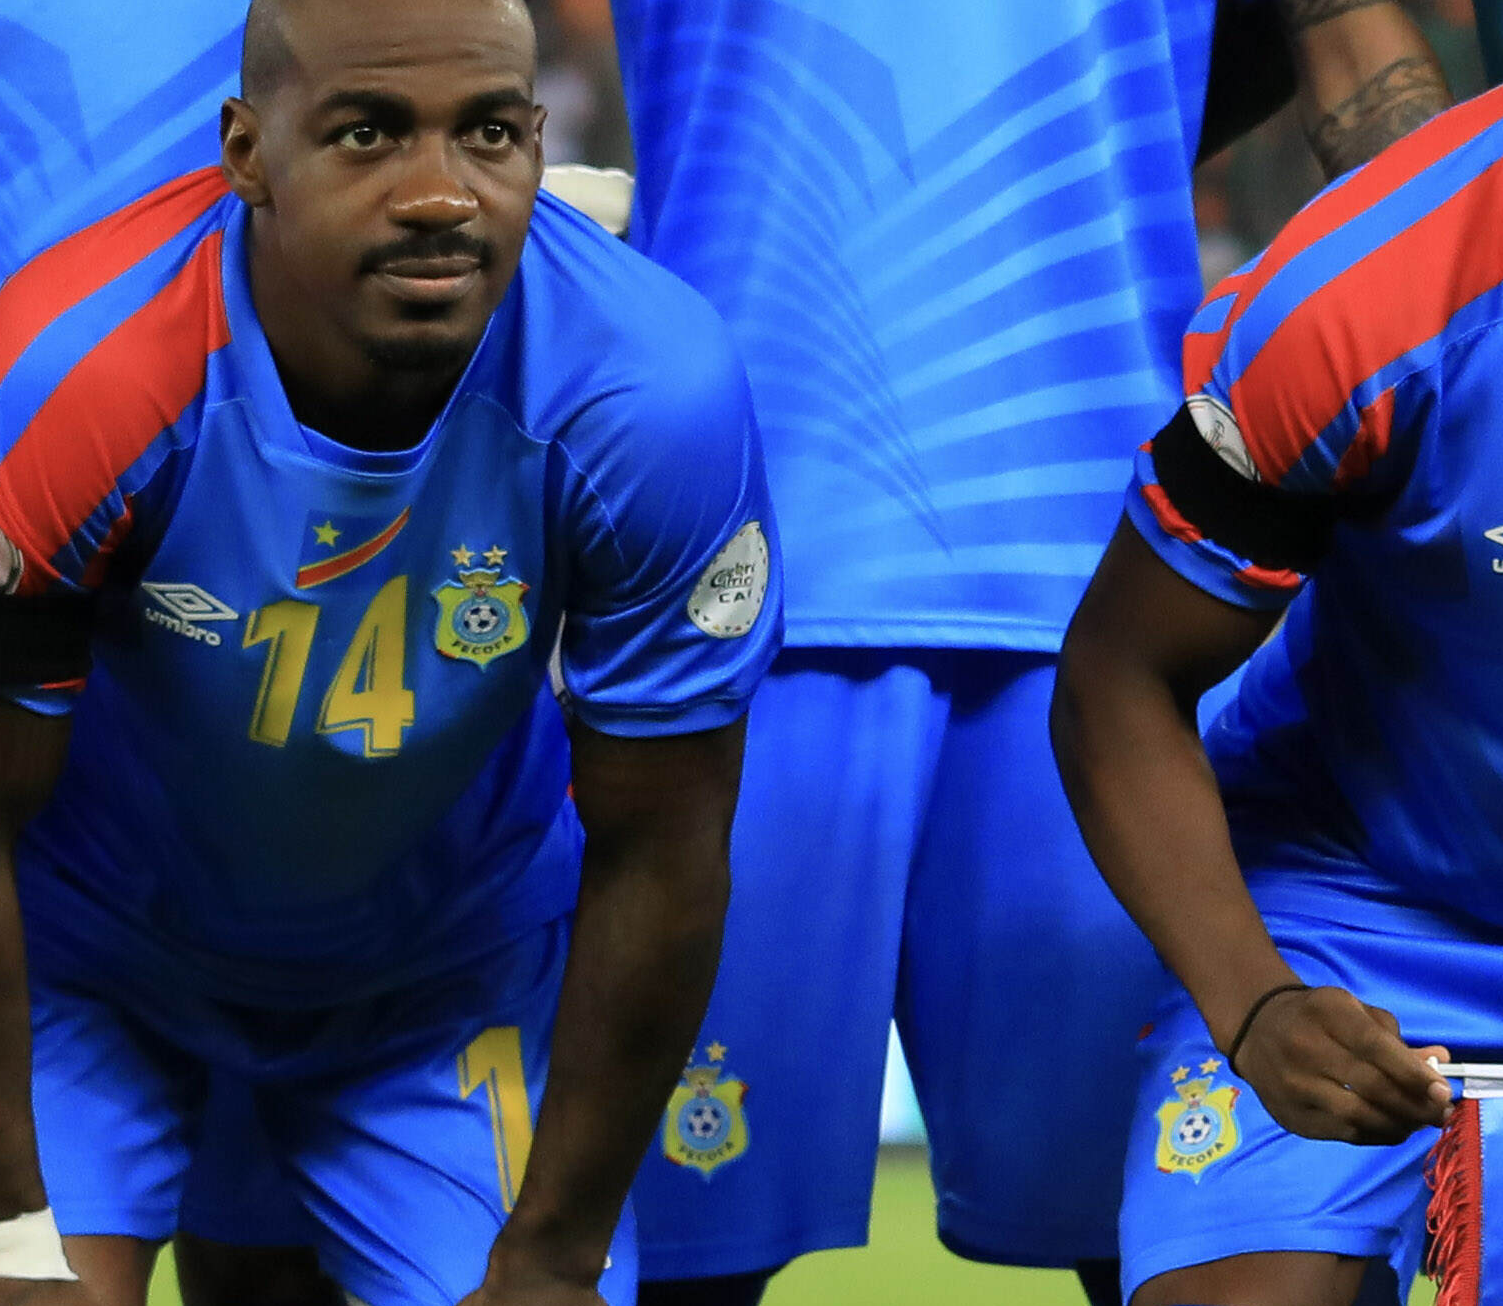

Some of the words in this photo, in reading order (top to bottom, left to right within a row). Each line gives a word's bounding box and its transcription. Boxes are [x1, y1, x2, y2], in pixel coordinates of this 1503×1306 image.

[144, 606, 223, 648] umbro
[451, 634, 515, 656] FECOFA
[243, 572, 415, 759] 14
[1168, 1141, 1225, 1167] FECOFA
